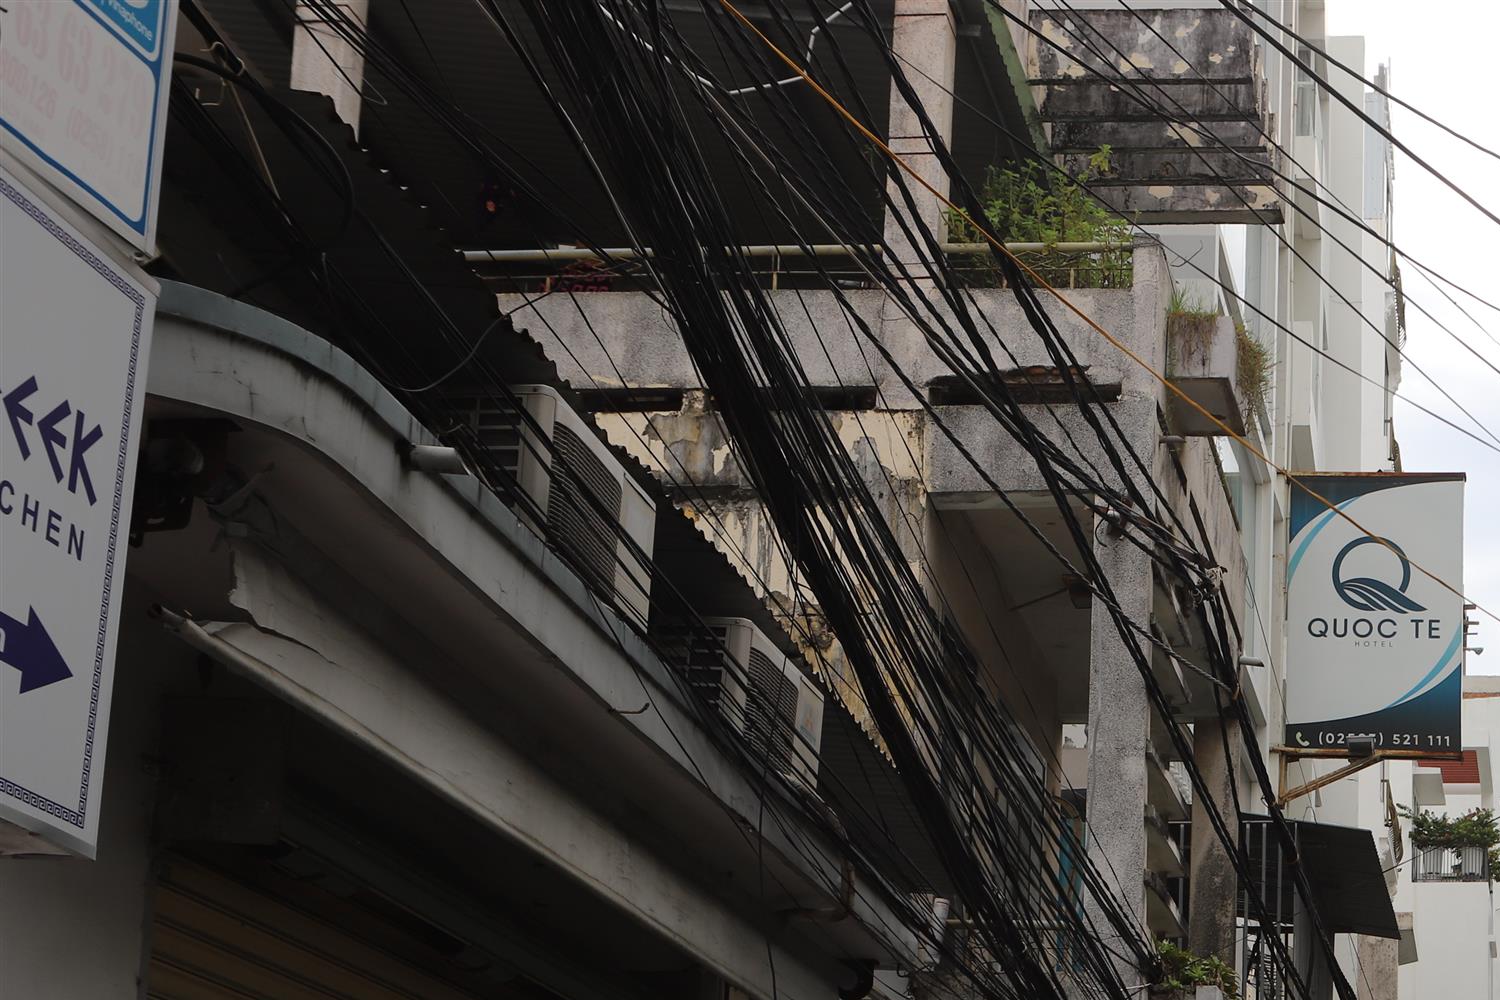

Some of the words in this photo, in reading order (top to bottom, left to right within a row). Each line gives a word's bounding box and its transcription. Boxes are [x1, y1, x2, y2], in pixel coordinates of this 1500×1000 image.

[1307, 617, 1399, 640] QUOC
[1410, 618, 1441, 640] TE
[1354, 640, 1394, 648] HOTEL
[1392, 733, 1420, 746] 521
[1427, 734, 1452, 748] 111
